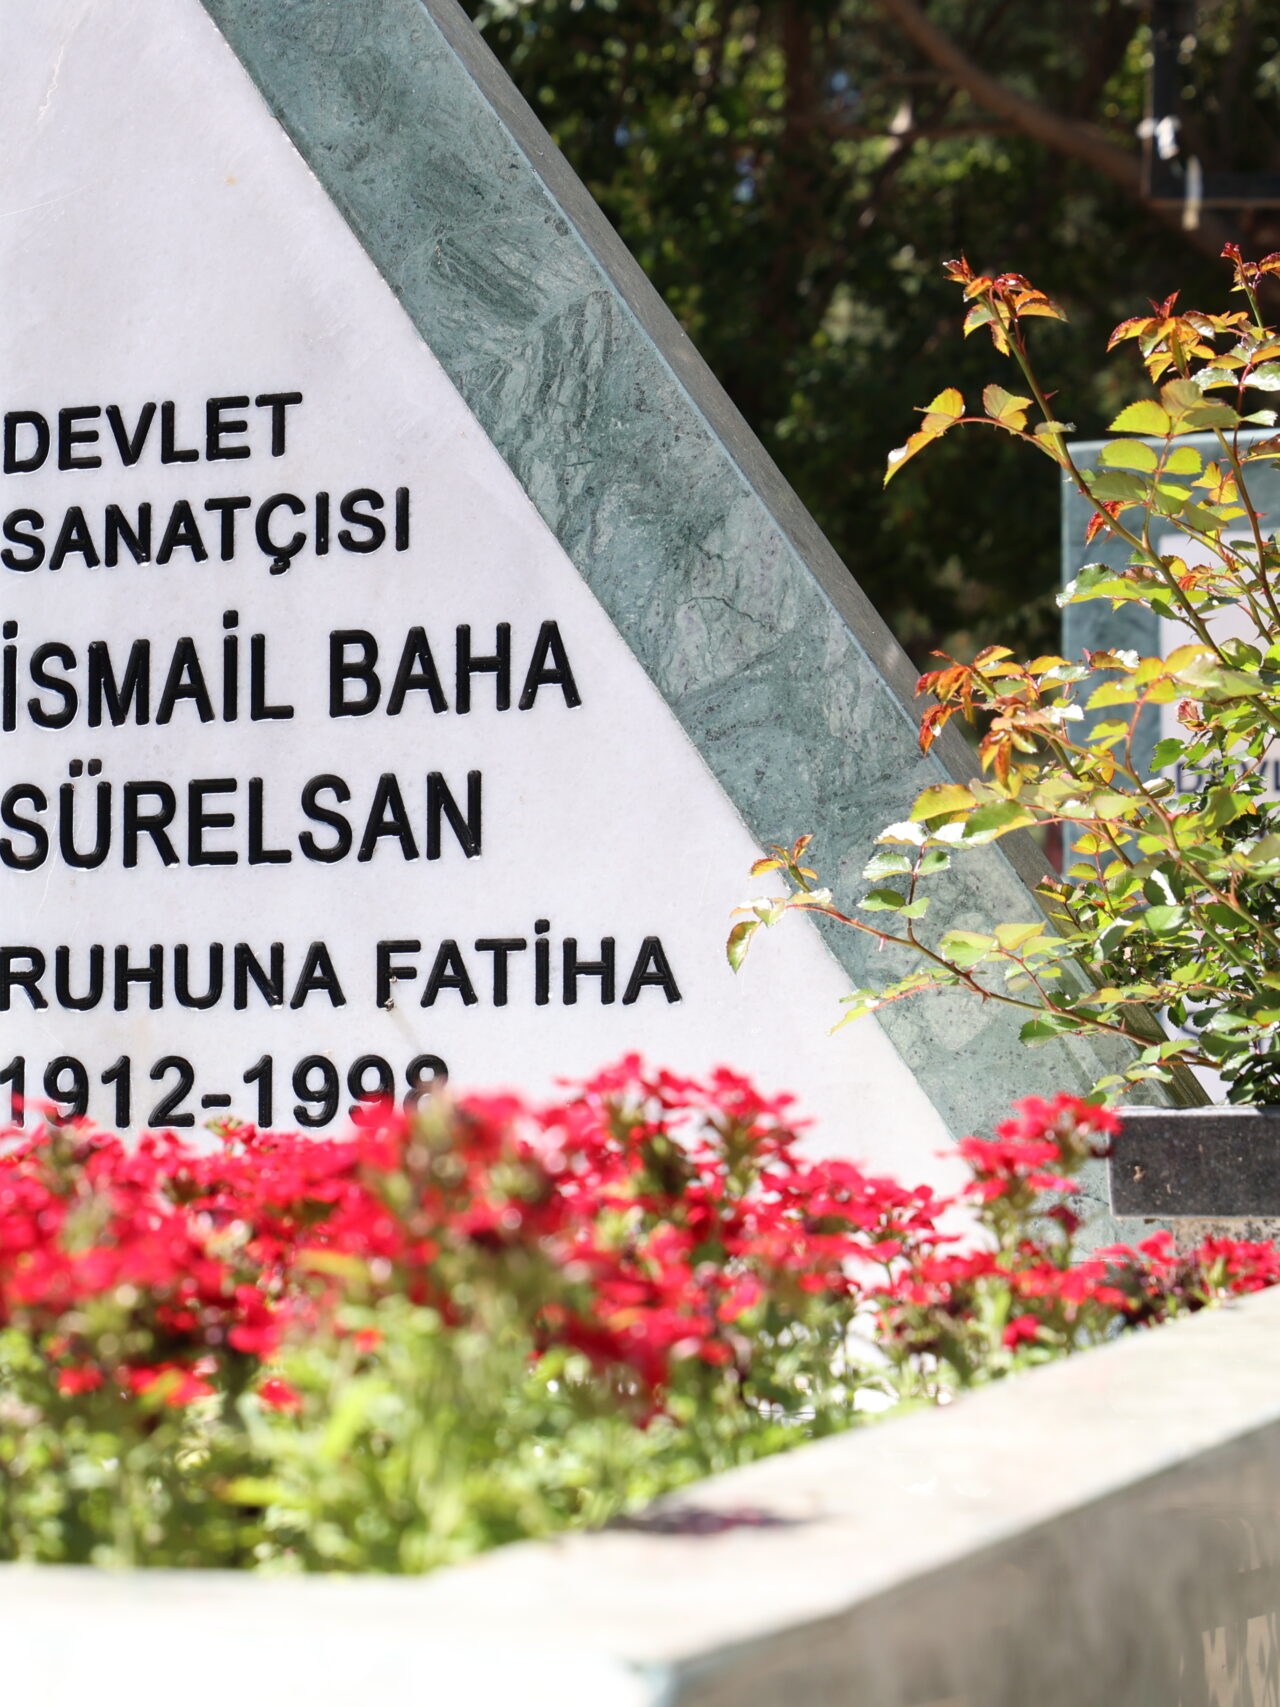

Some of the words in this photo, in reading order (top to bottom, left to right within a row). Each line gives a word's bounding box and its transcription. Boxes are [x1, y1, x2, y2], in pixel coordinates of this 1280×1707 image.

[3, 391, 303, 475] DEVLET
[0, 486, 410, 576] SANATÇISI
[1, 609, 295, 732] İSMAİL
[329, 620, 582, 719] BAHA
[376, 919, 683, 1012] FATİHA
